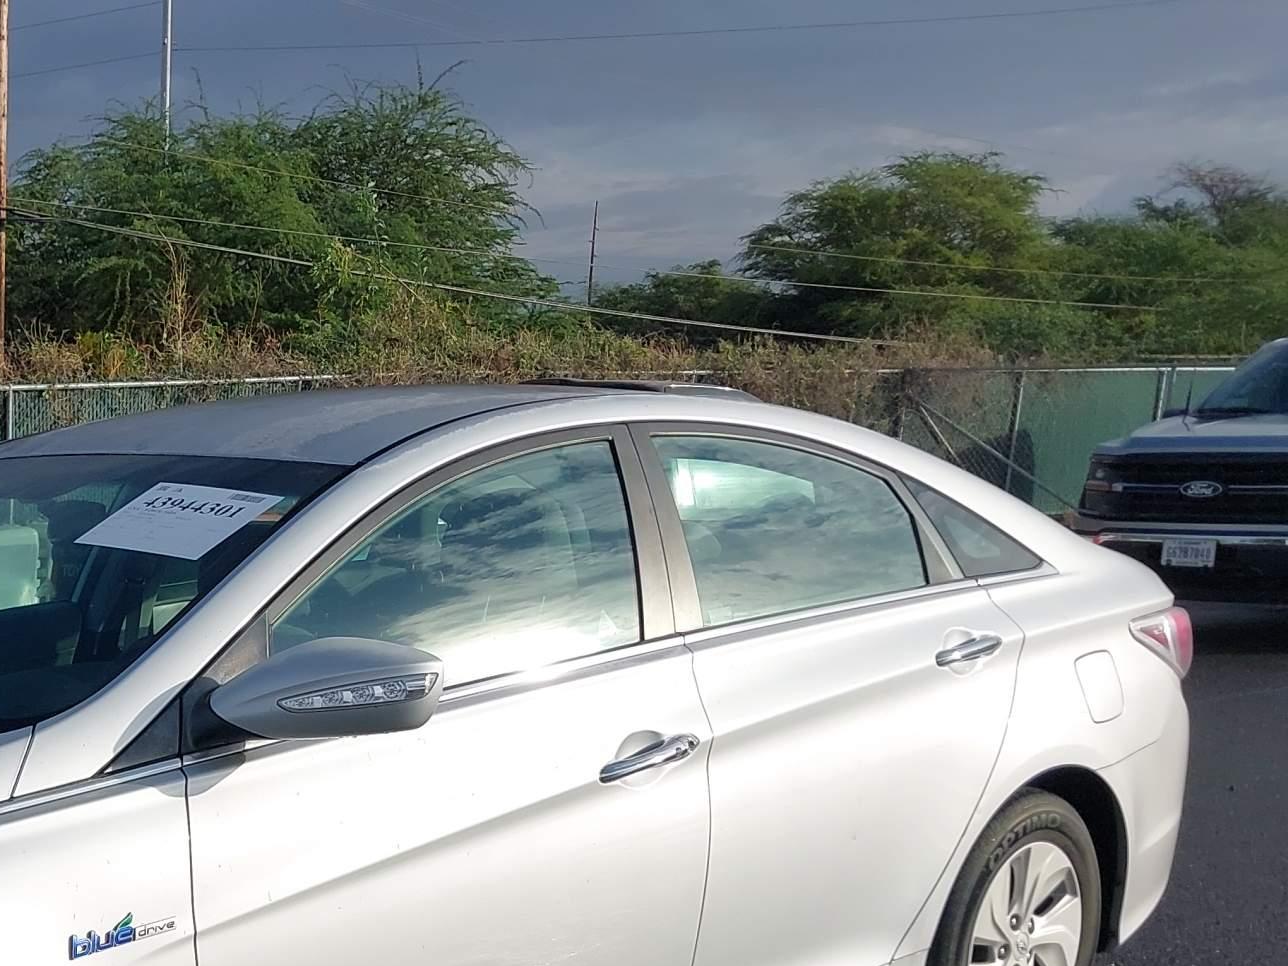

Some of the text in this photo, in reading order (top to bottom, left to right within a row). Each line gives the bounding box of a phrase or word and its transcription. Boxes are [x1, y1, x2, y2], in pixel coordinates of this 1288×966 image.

[143, 496, 246, 519] 43944301
[989, 812, 1061, 870] OPTIMO
[68, 920, 176, 961] blue drive
